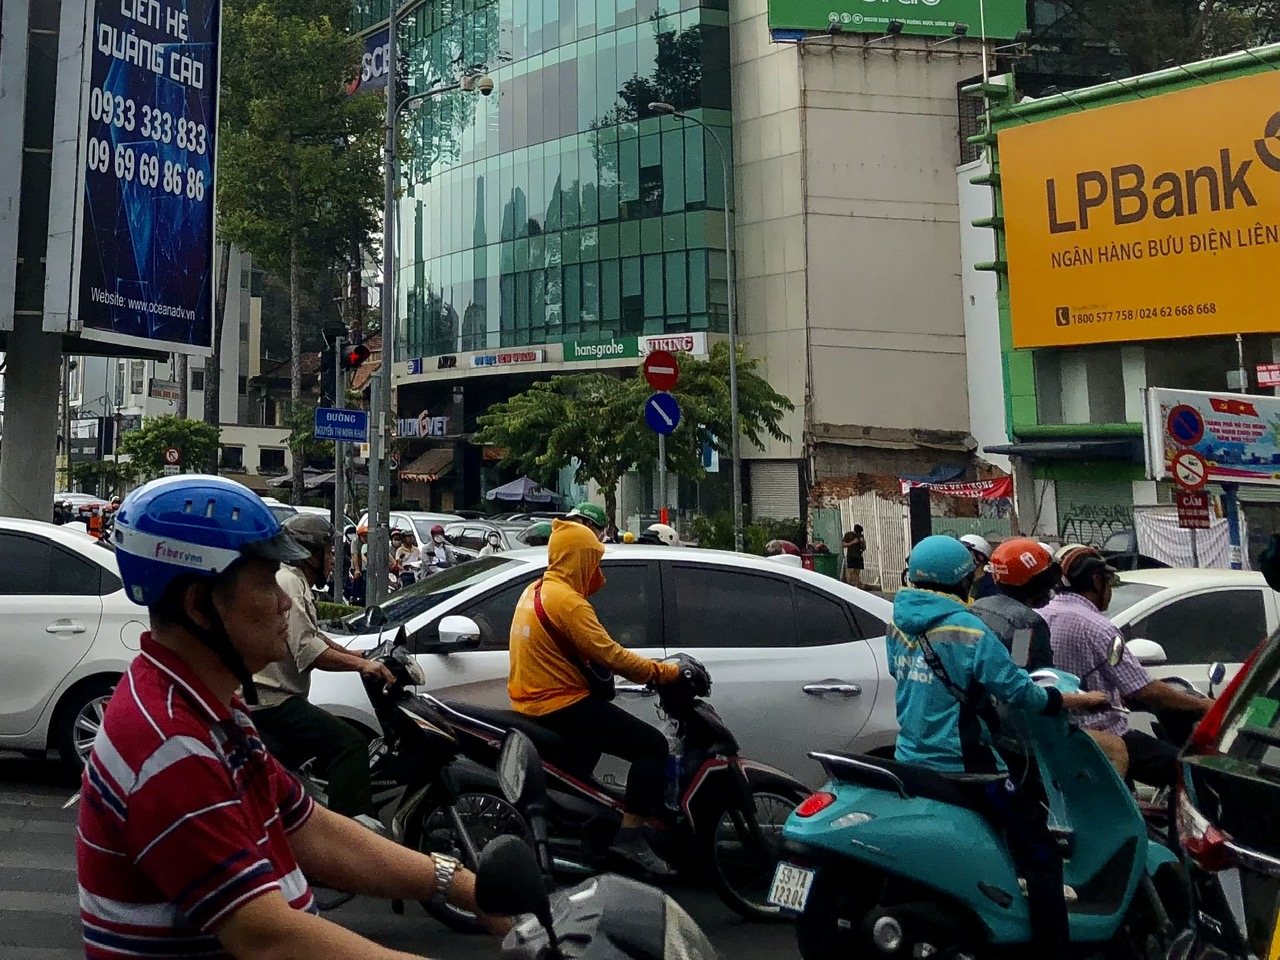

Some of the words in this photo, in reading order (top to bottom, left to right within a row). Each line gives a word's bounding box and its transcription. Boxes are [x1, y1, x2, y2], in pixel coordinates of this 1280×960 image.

[166, 6, 189, 44] HỆ
[98, 23, 164, 75] QUẢNG
[170, 52, 204, 89] CÁO
[91, 87, 136, 132] 0933
[141, 104, 171, 144] 333
[176, 117, 206, 155] 833
[88, 137, 110, 173] 09
[114, 144, 135, 181] 69
[139, 153, 159, 189] 69
[163, 160, 183, 195] 86
[186, 166, 205, 202] 86
[1046, 148, 1258, 234] LPBank
[1051, 246, 1094, 269] NGÂN
[1097, 241, 1143, 263] HÀNG
[1148, 235, 1184, 257] BƯU
[1189, 228, 1232, 256] ĐIỆN
[1237, 222, 1279, 247] LIÊN
[91, 286, 126, 308] Website:
[127, 297, 196, 321] www.oceanadv.vn
[1072, 312, 1094, 325] 1800
[1096, 311, 1113, 323] 577
[1160, 306, 1173, 318] 62
[1174, 304, 1194, 316] 668
[1196, 302, 1217, 315] 668
[574, 339, 624, 358] hansgrohe
[646, 336, 693, 352] VIKING
[326, 411, 356, 423] ĐƯỜNG
